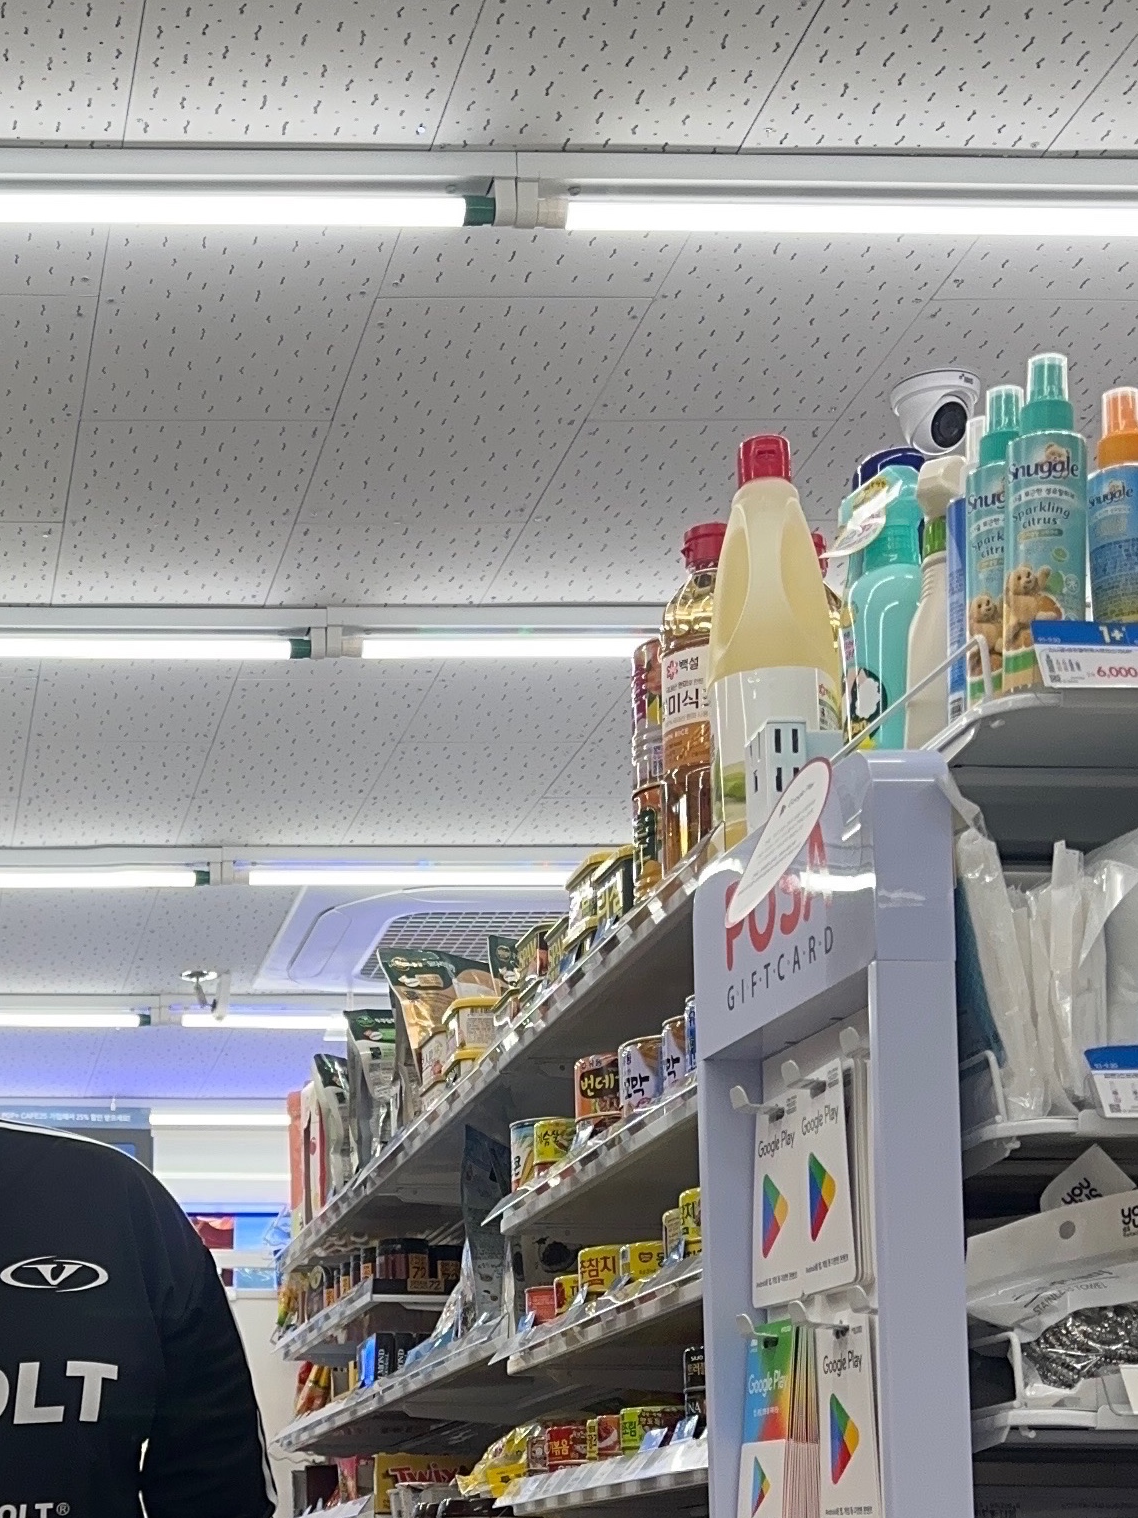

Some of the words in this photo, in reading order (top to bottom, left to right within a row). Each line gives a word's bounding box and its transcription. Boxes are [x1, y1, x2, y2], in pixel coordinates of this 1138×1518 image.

[1008, 457, 1079, 483] Snuggle
[1022, 516, 1058, 530] citrus
[680, 656, 699, 672] 백설
[802, 1110, 824, 1137] Google
[824, 1104, 839, 1125] Play
[758, 1135, 780, 1158] Google
[780, 1129, 796, 1150] Play
[823, 1354, 847, 1378] Google
[847, 1350, 862, 1374] Play
[748, 1373, 773, 1398] Google
